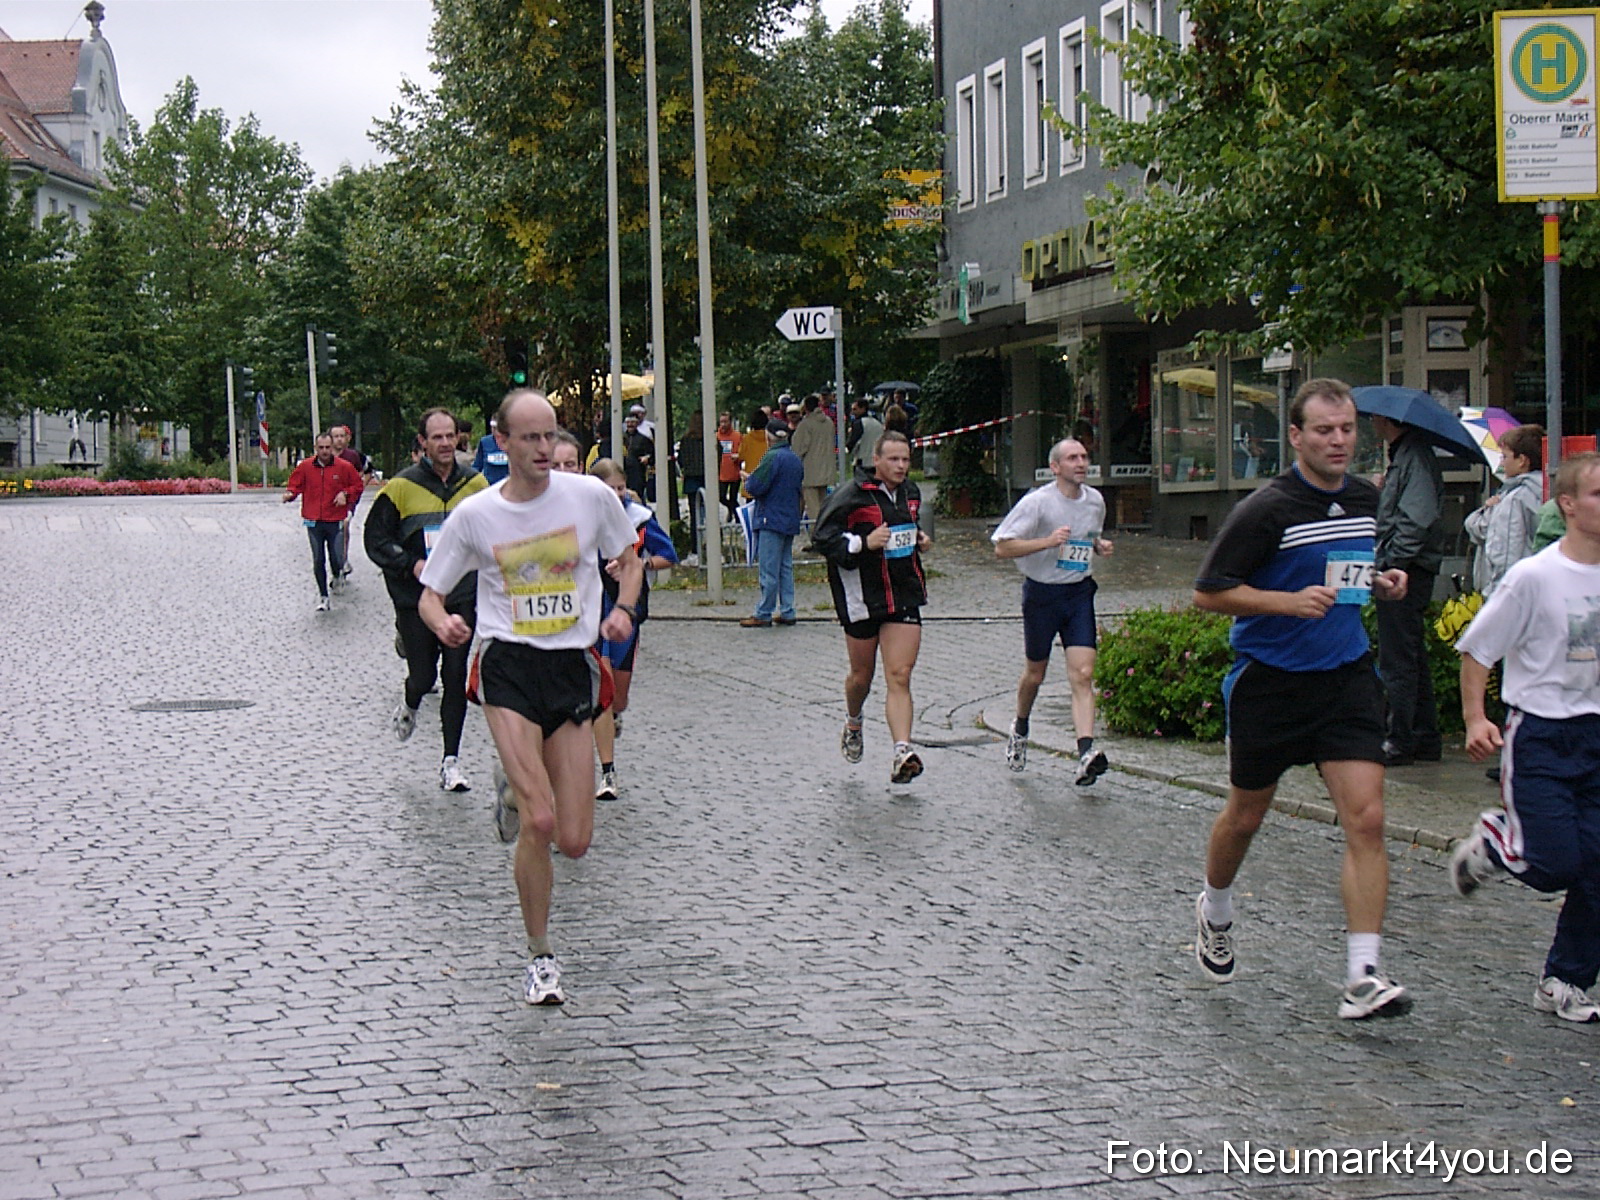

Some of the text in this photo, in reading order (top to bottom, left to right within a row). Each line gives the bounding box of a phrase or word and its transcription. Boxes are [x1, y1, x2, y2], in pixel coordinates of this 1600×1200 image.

[1531, 42, 1567, 85] H
[1509, 112, 1589, 125] Oberer Markt
[793, 312, 827, 336] WC
[895, 532, 911, 548] 529
[1069, 545, 1089, 561] 272
[525, 593, 573, 617] 1578
